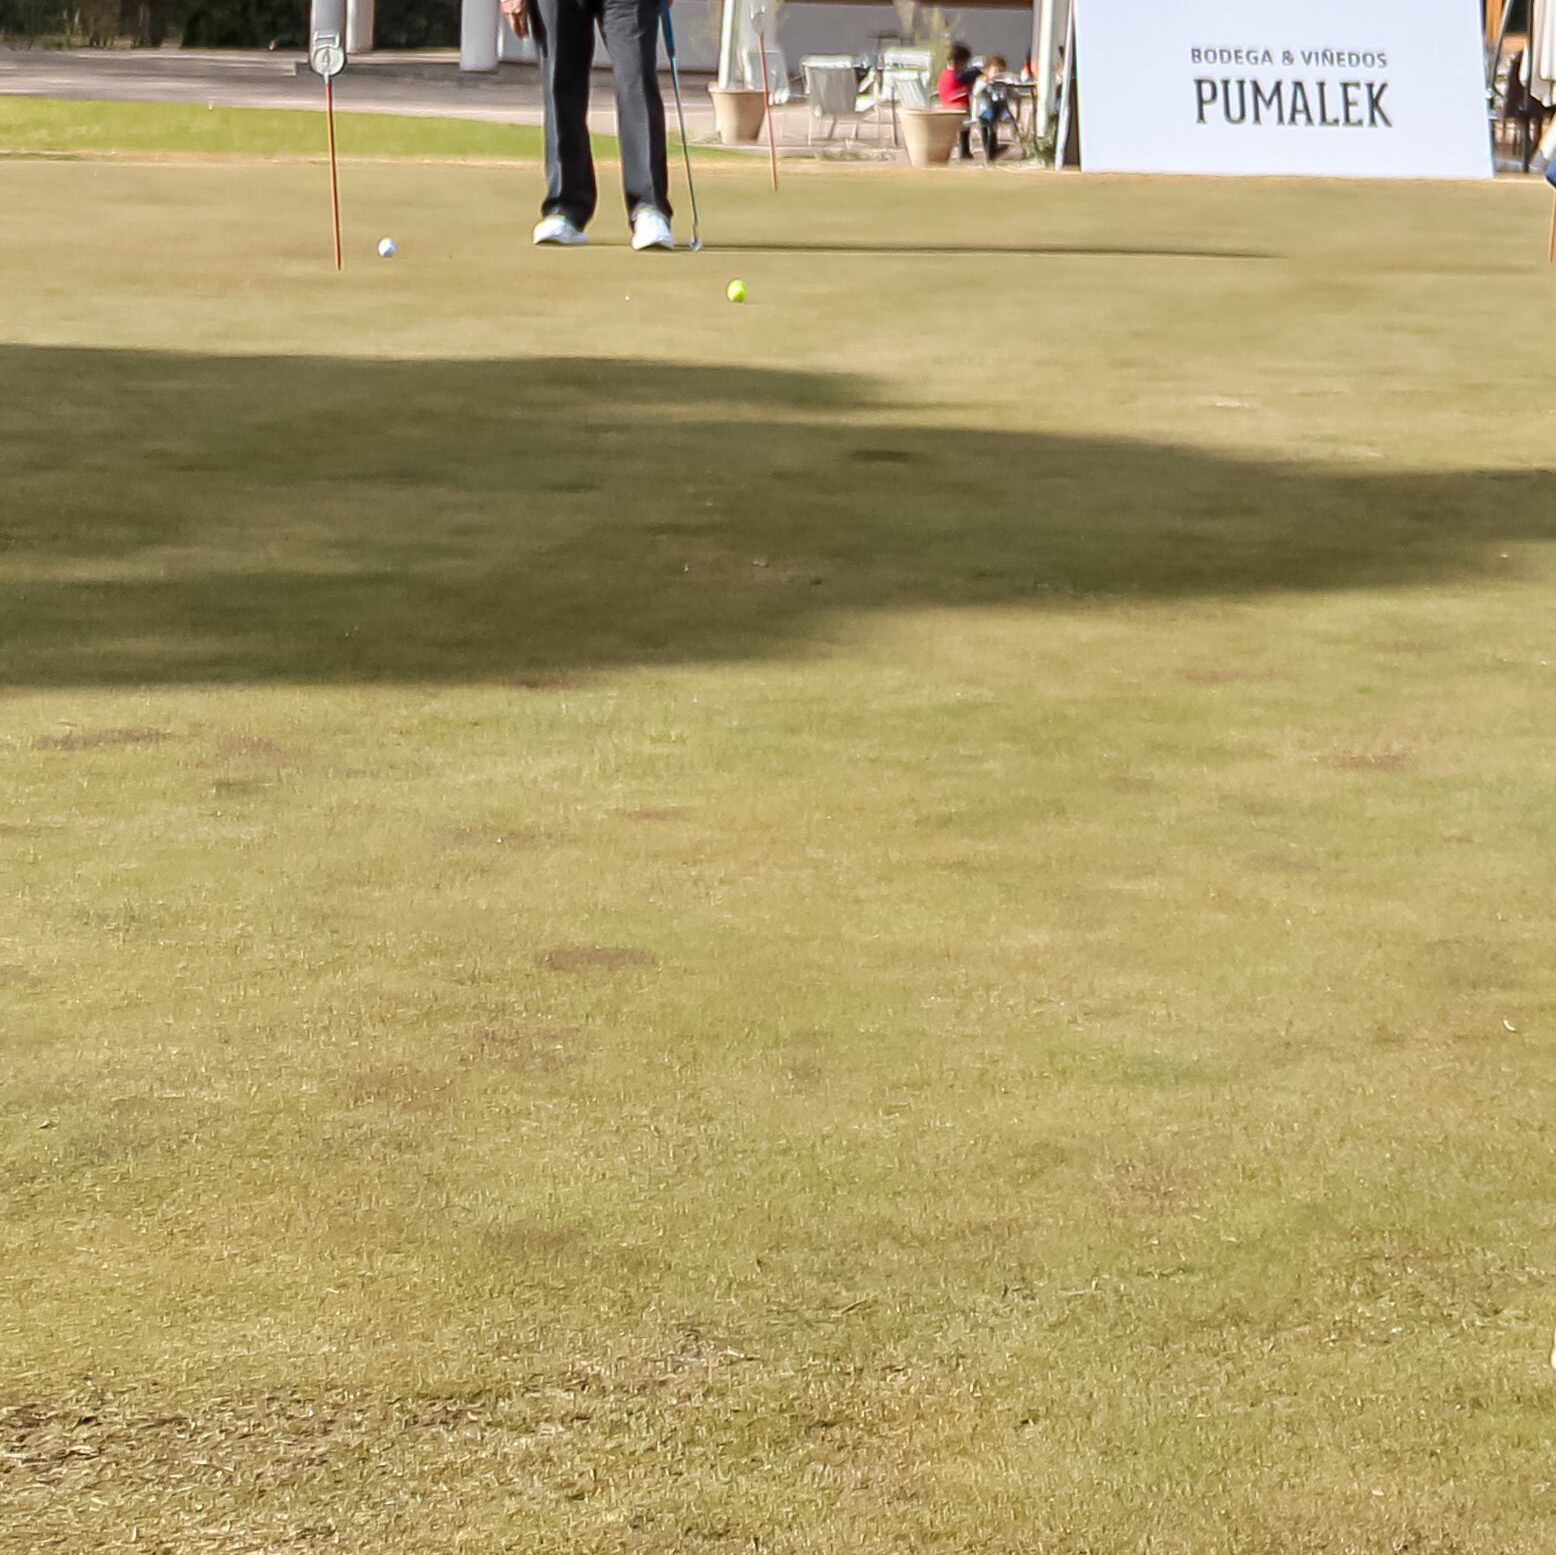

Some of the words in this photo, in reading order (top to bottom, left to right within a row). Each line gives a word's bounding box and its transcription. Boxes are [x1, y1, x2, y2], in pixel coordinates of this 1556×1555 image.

[1191, 48, 1273, 66] BODEGA
[1282, 49, 1294, 66] &
[1301, 48, 1388, 68] VIÑEDOS
[1193, 78, 1393, 128] PUMALEK
